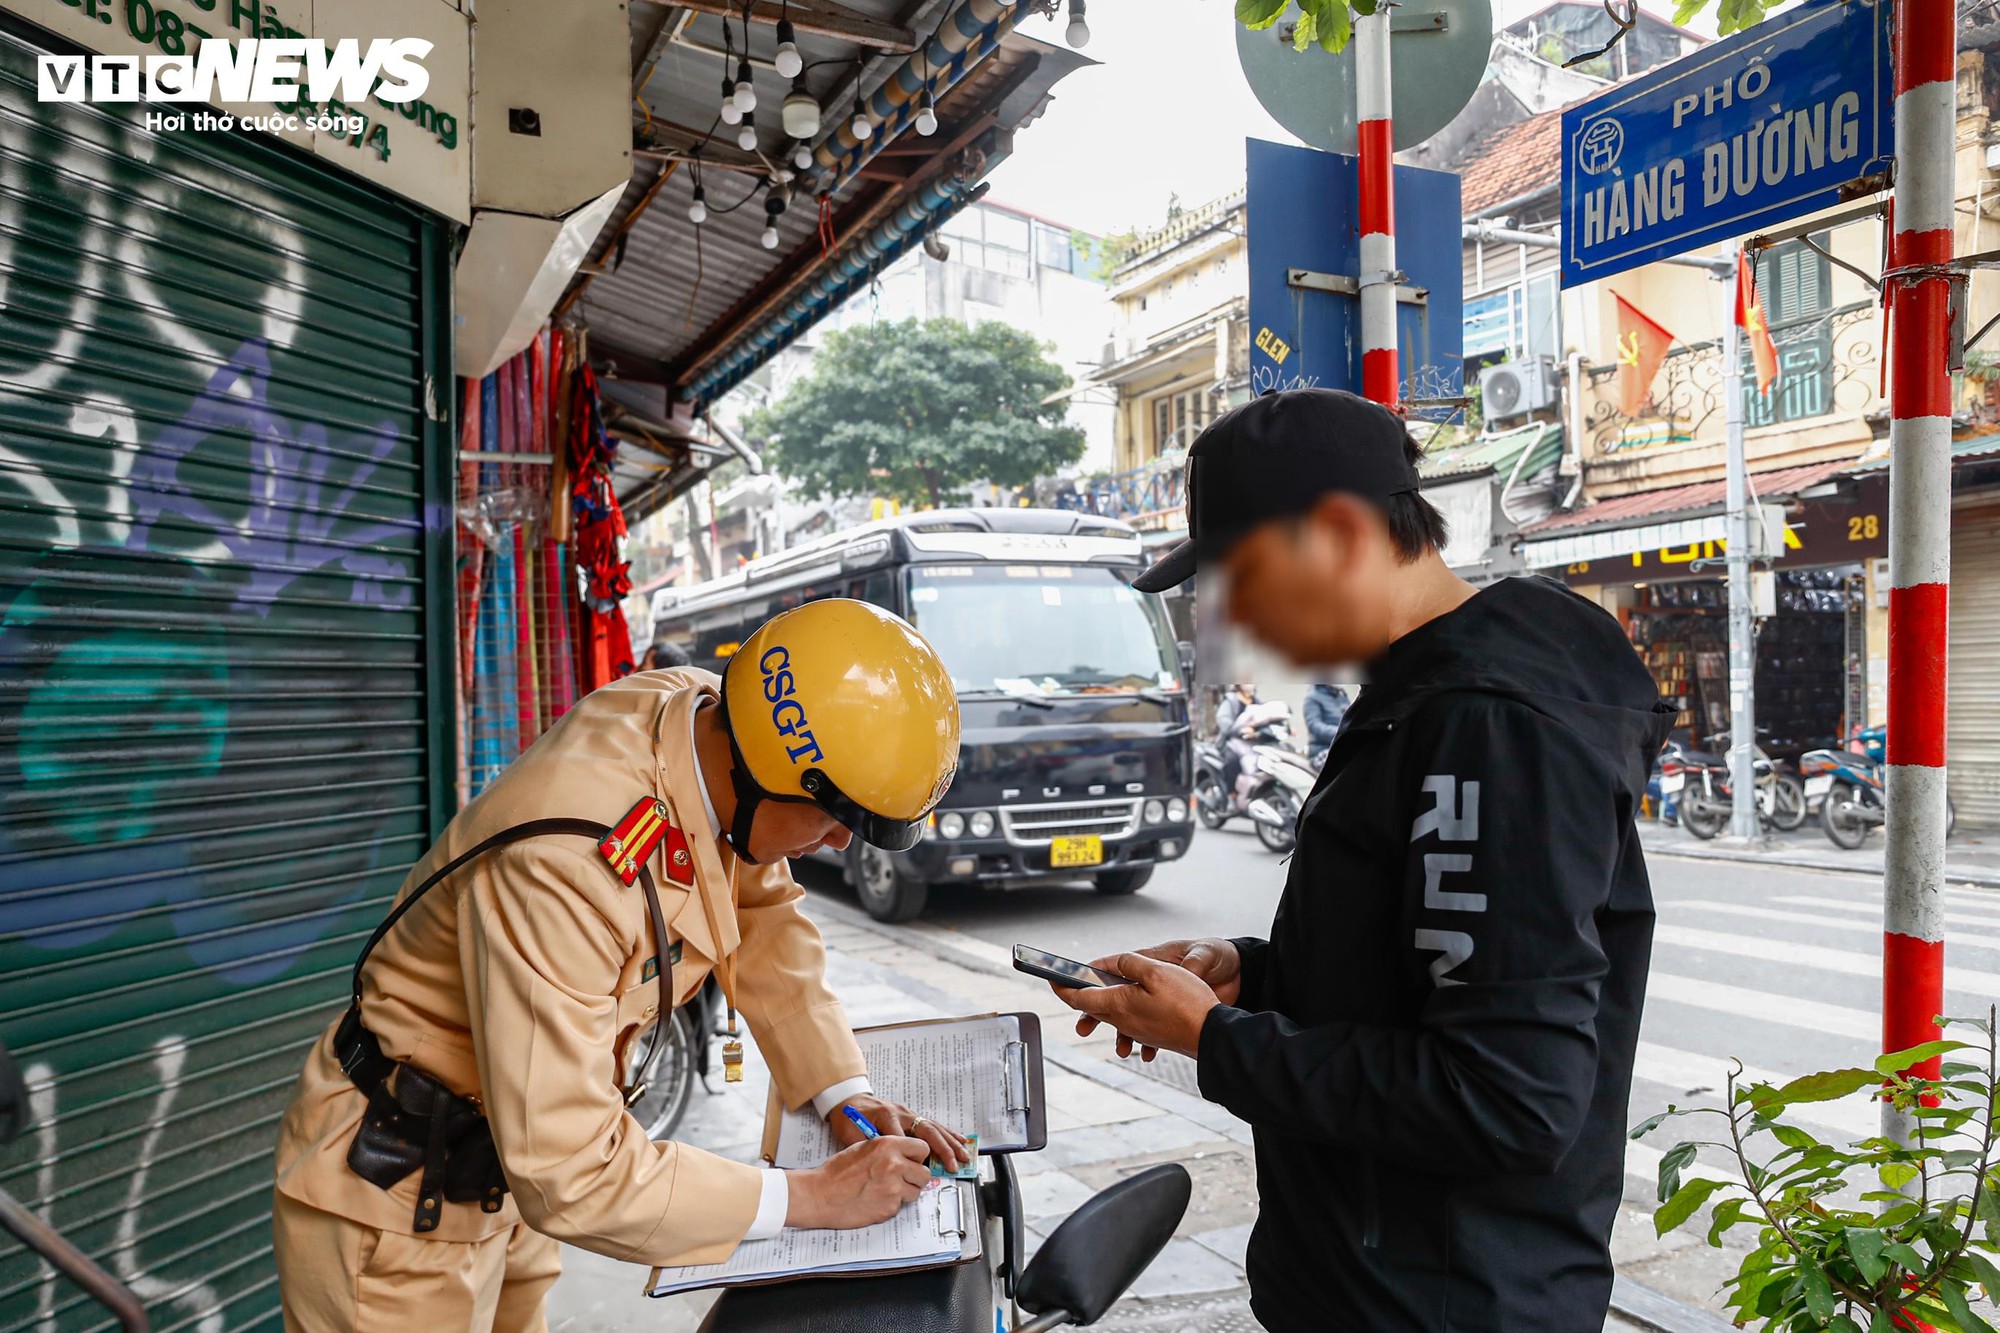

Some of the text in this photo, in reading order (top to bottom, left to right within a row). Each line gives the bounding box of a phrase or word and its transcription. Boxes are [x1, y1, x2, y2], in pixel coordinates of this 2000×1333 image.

[1673, 43, 1776, 129] PHỐ
[1584, 91, 1860, 249] HÀNG ĐƯỜNG
[1254, 327, 1291, 365] GLEN
[1848, 514, 1879, 541] 28
[760, 646, 824, 764] CSGT
